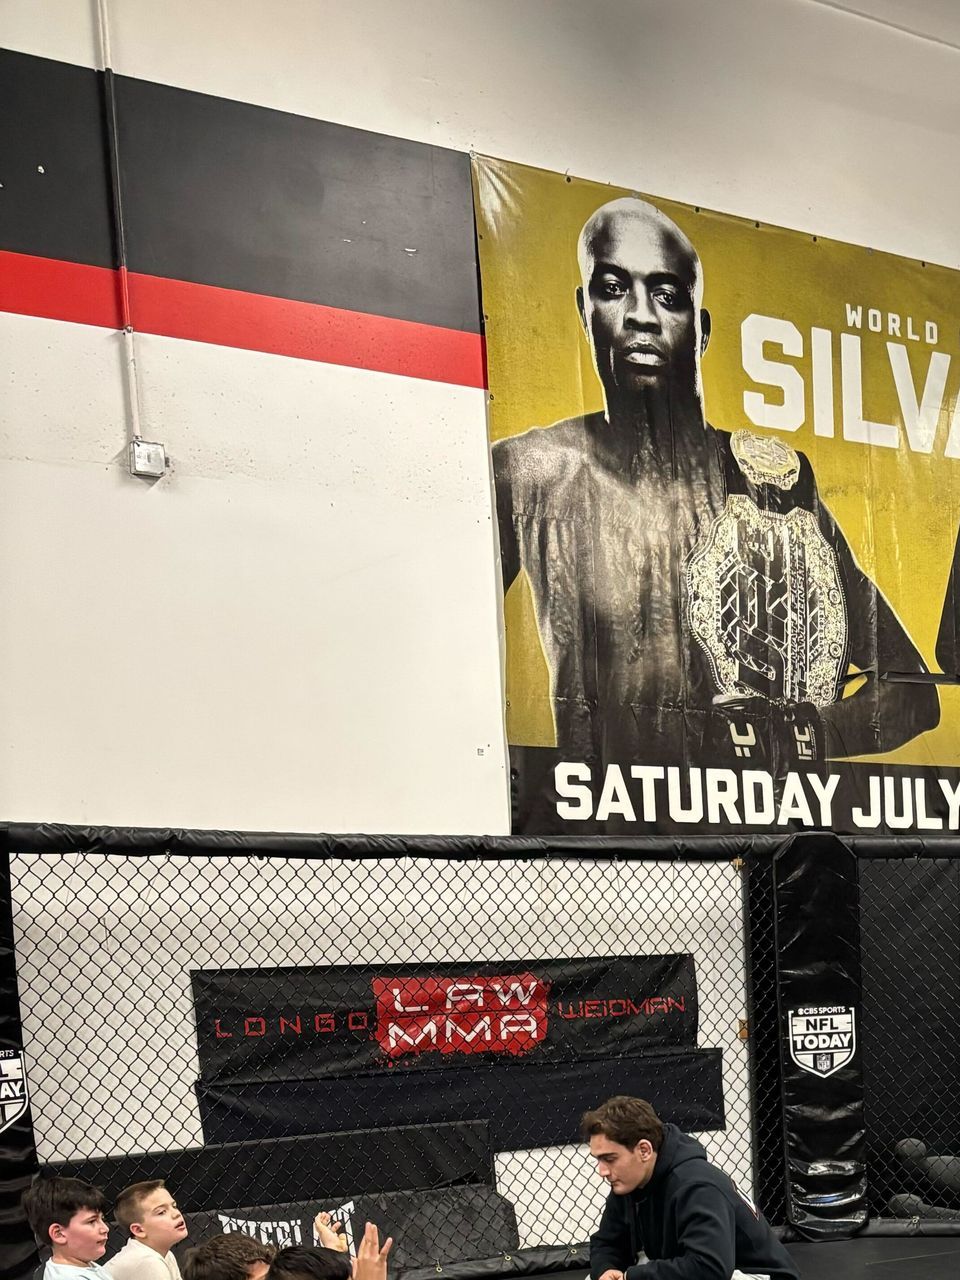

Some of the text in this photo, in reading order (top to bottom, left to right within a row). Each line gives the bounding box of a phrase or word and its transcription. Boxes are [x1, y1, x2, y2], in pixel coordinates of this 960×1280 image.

[845, 303, 938, 345] WORLD
[554, 761, 841, 827] SATURDAY
[392, 981, 538, 1013] LAW
[558, 996, 686, 1019] WEIDMAN
[803, 1006, 846, 1015] CBS SPORTS
[214, 1011, 368, 1039] LONGO
[388, 1015, 538, 1048] MMA
[805, 1017, 839, 1032] NFL
[793, 1033, 852, 1050] TODAY
